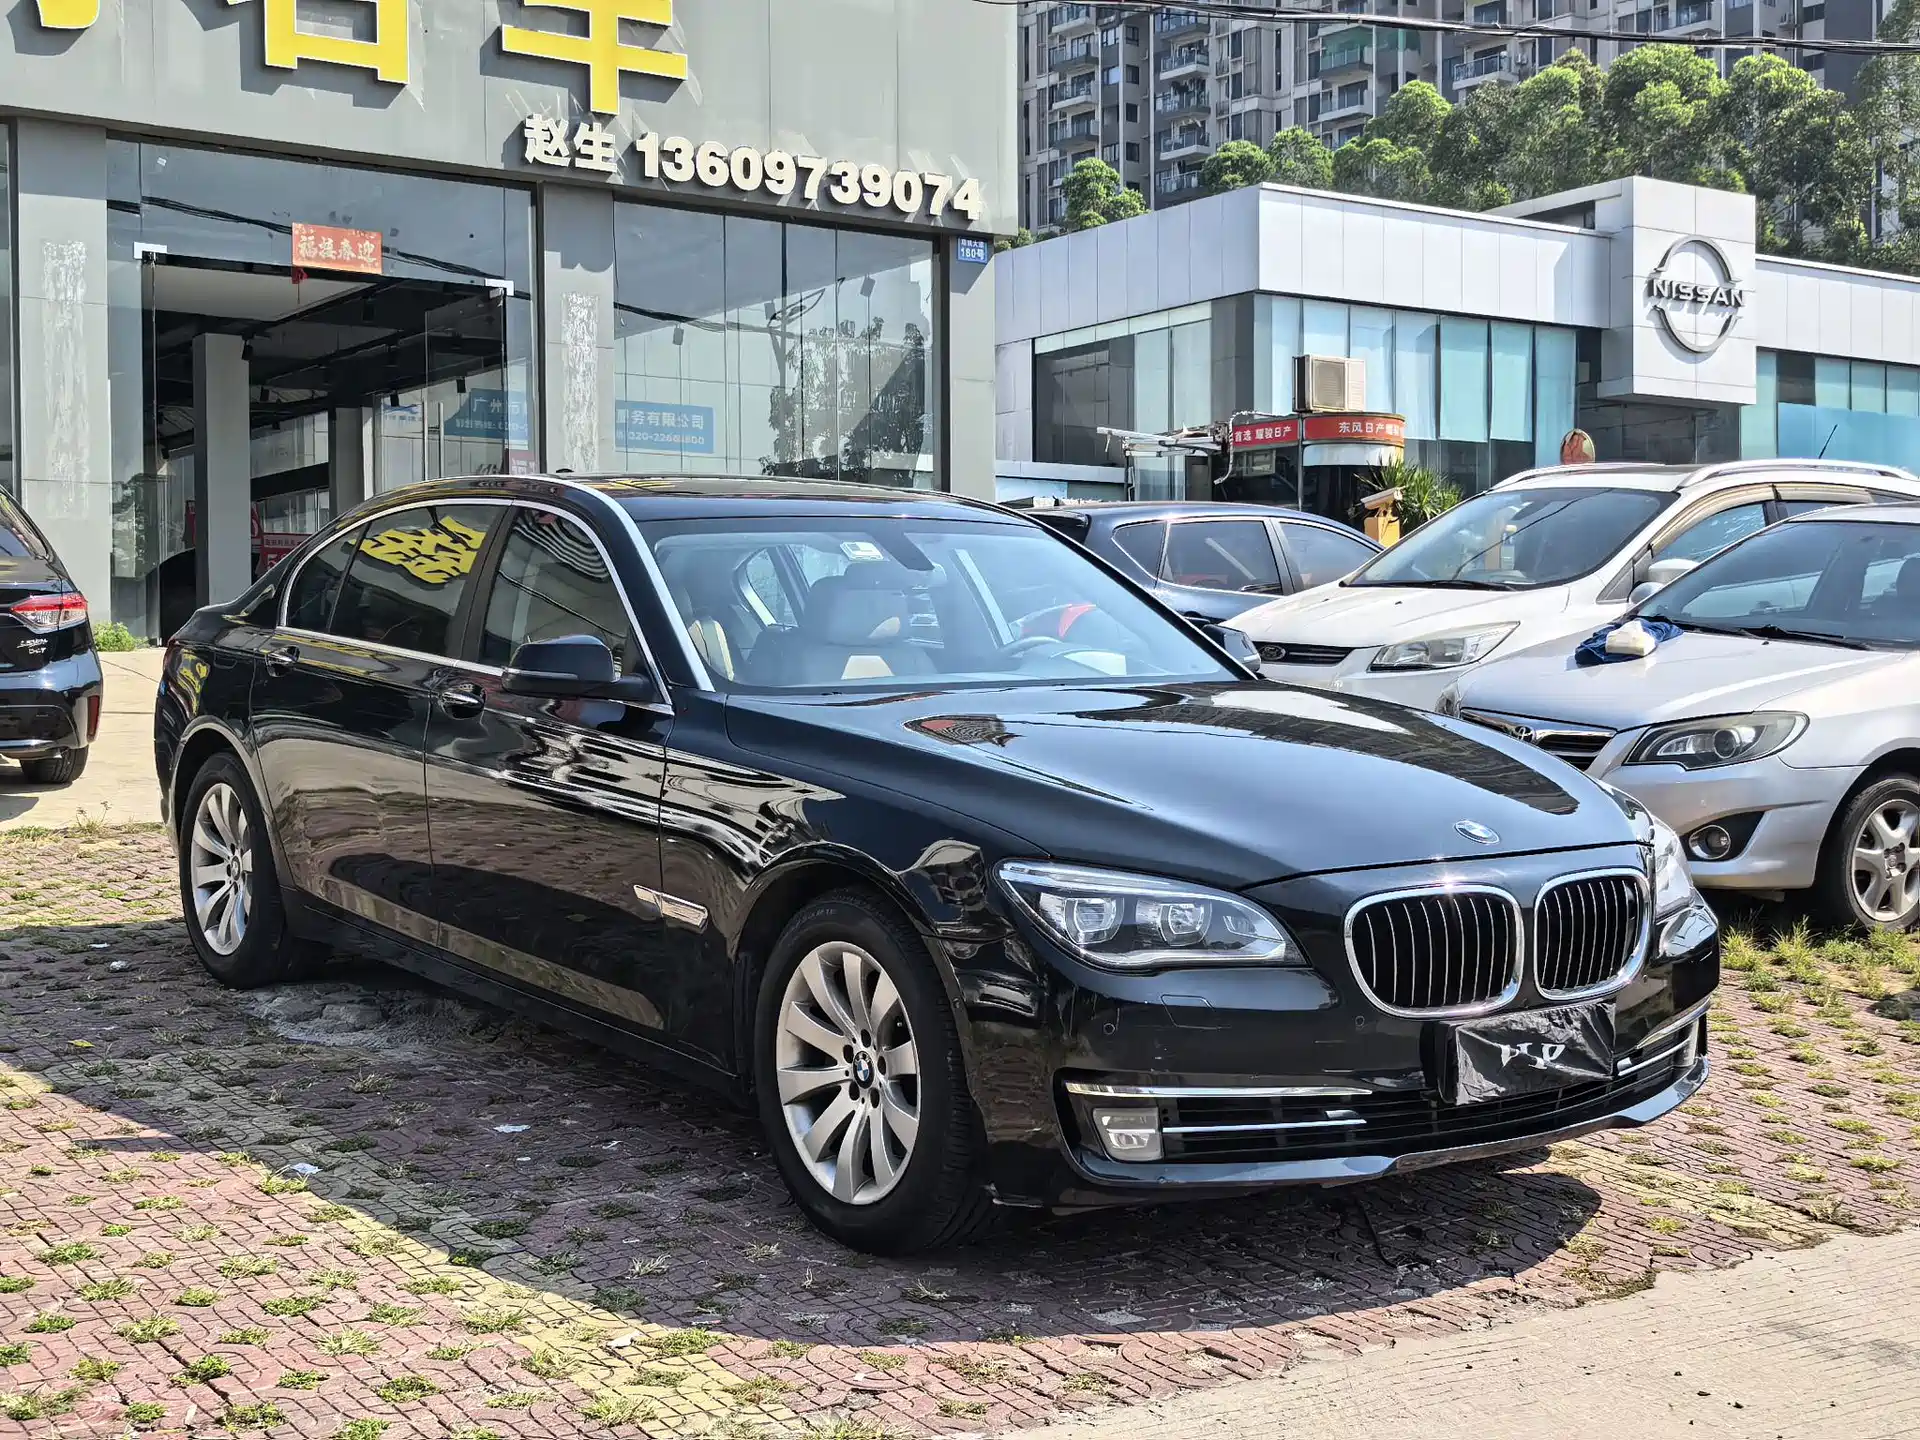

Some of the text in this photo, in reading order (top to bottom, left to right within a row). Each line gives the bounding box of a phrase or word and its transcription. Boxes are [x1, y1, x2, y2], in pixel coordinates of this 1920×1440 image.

[524, 113, 982, 221] 赵生 13609739074
[1649, 278, 1745, 308] NISSAN
